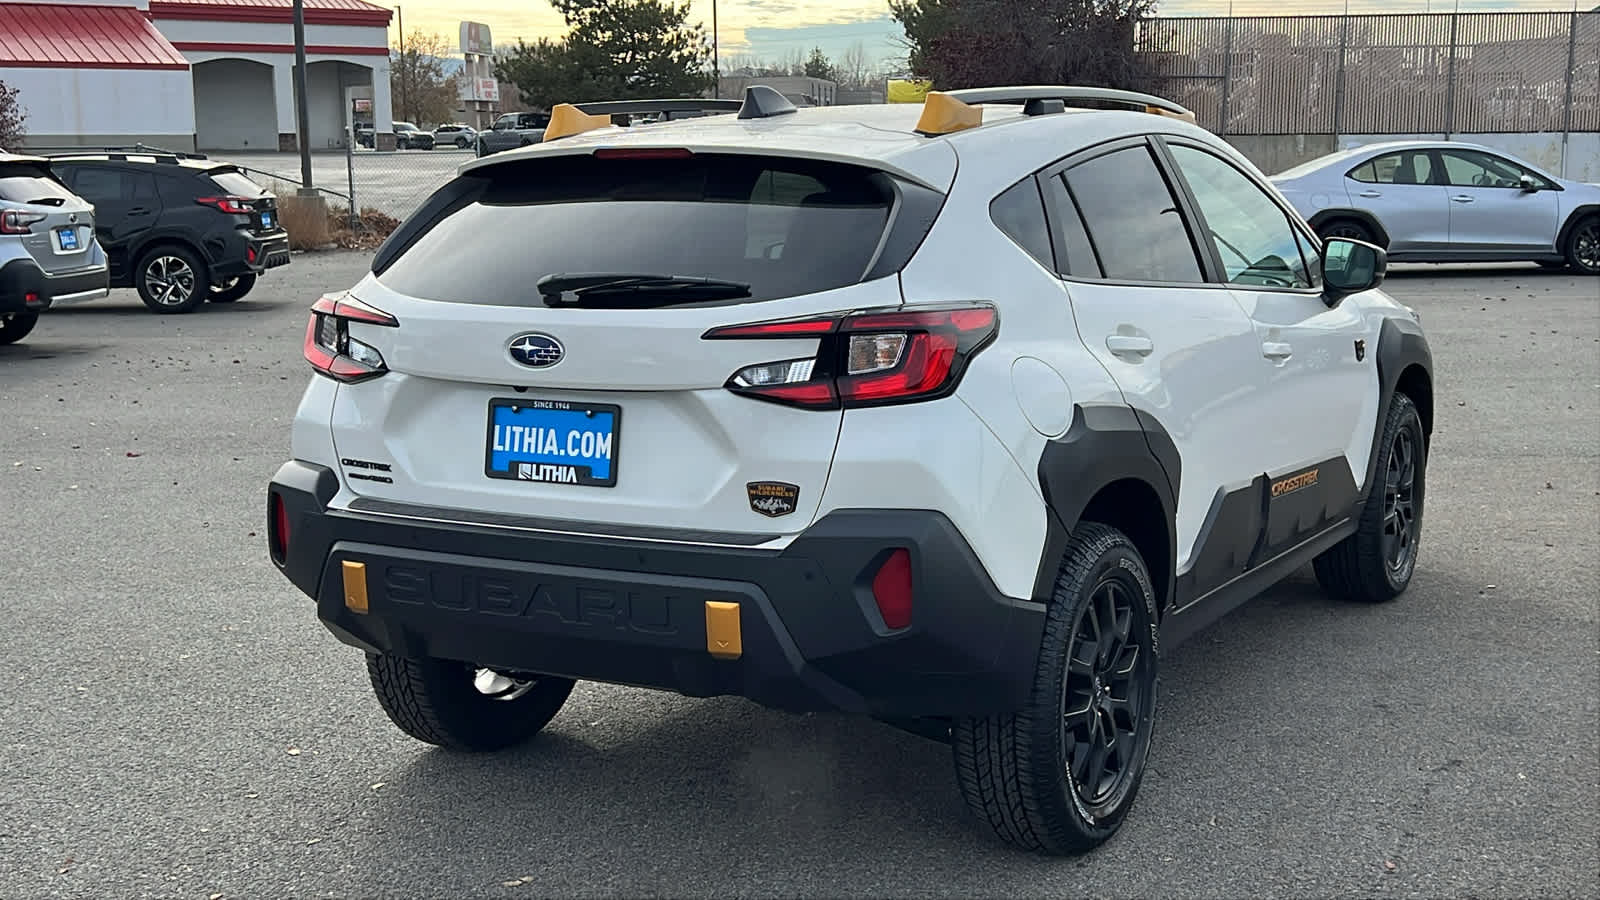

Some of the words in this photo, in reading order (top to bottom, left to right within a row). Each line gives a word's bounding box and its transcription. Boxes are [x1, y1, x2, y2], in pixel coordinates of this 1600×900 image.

[533, 401, 553, 409] SINCE
[555, 402, 570, 410] 1946
[493, 424, 613, 460] LITHIA.COM
[532, 463, 578, 483] LITHIA
[1271, 469, 1319, 497] CROSSTREK
[750, 489, 794, 497] WILDERNESS
[385, 565, 679, 635] SUBARU
